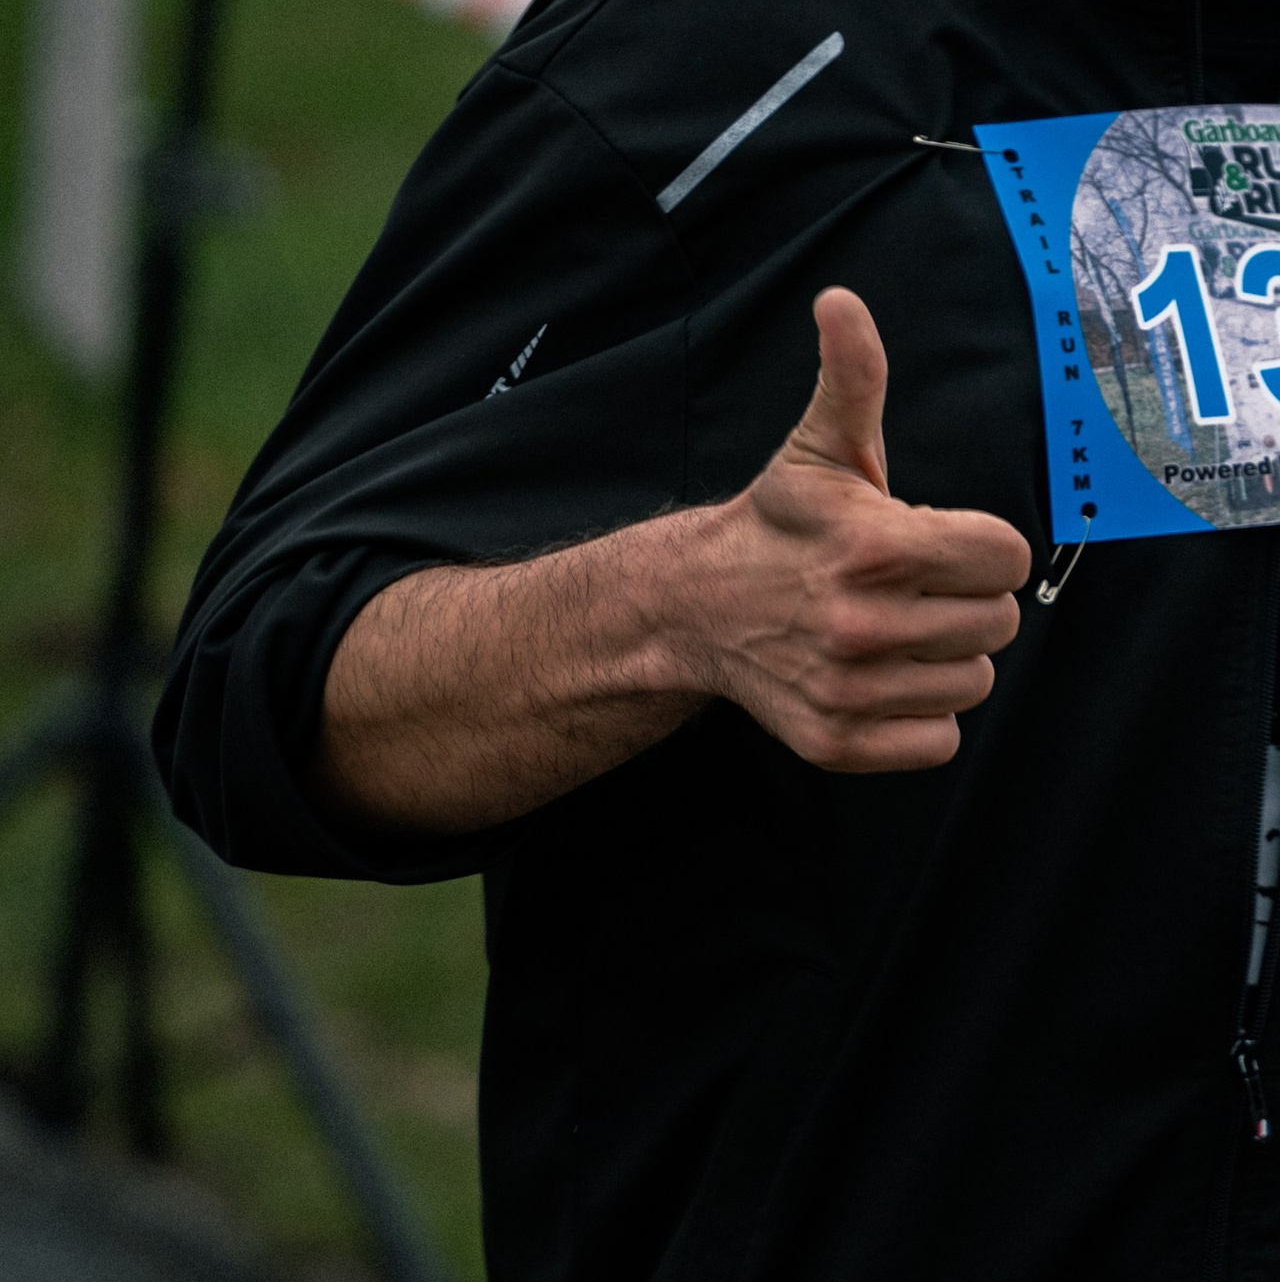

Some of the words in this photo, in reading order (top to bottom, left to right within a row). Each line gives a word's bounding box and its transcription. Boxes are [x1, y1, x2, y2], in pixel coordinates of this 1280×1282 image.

[1225, 163, 1249, 191] &
[1010, 166, 1060, 274] TRAIL
[1056, 310, 1080, 381] RUN
[1070, 419, 1092, 491] 7KM
[1164, 455, 1272, 485] Powered
